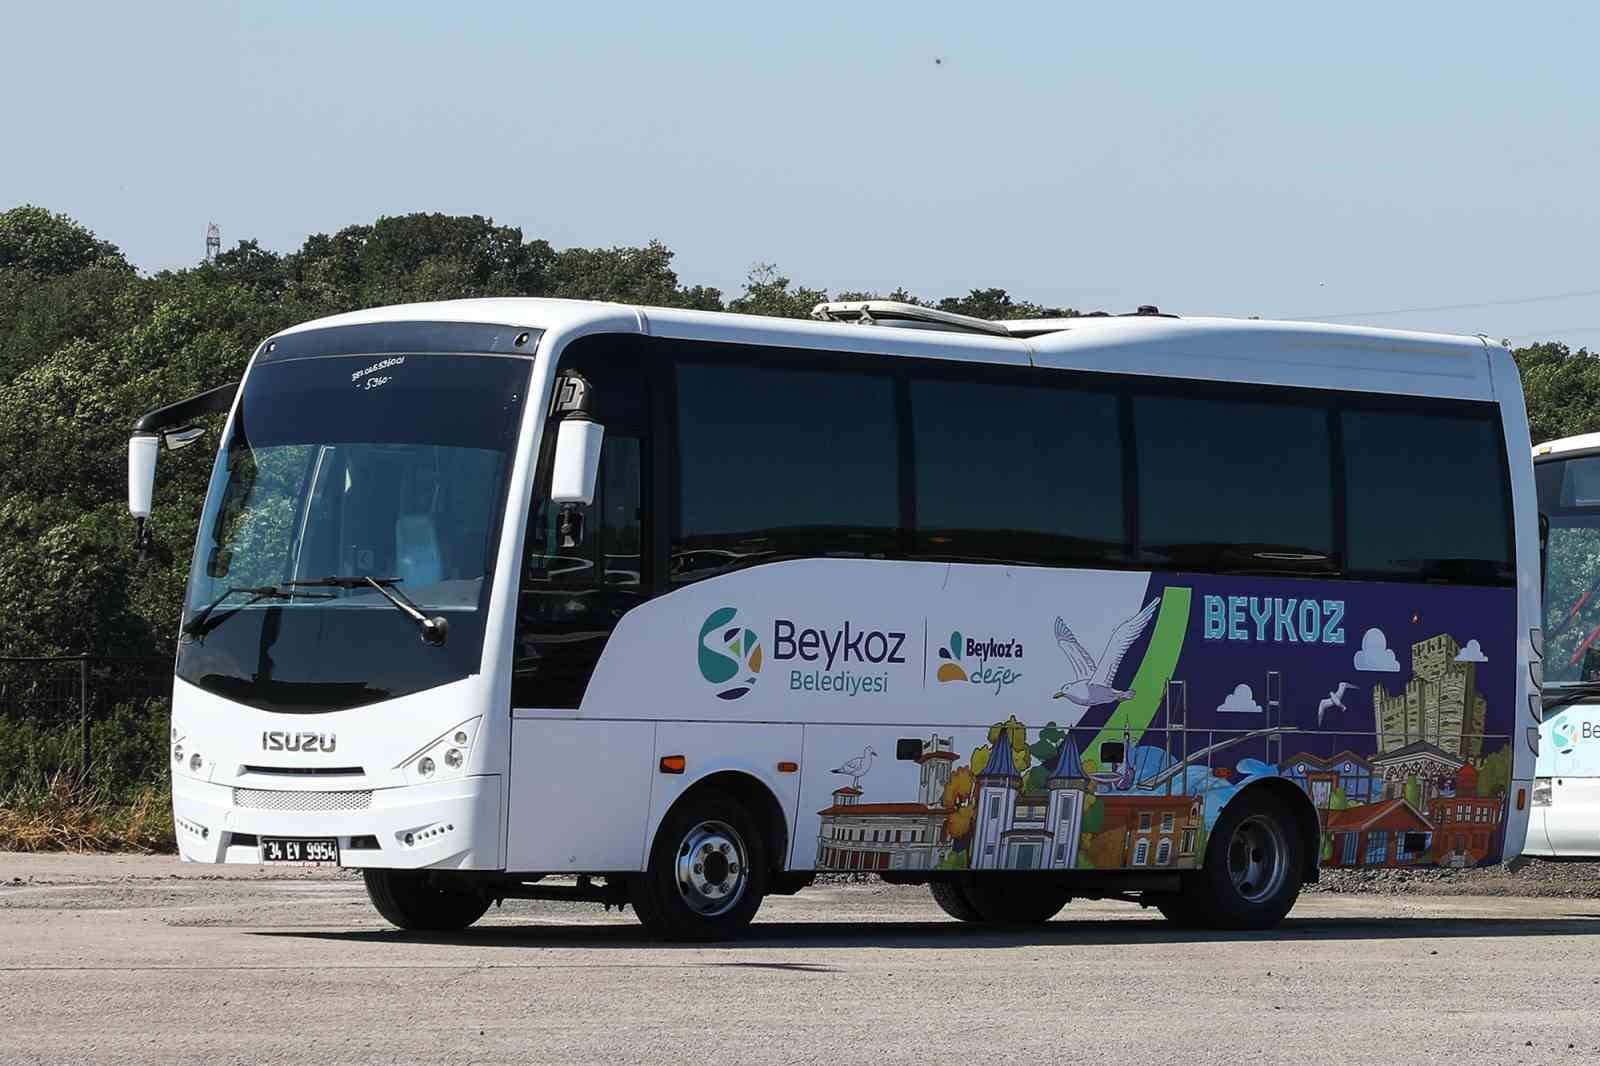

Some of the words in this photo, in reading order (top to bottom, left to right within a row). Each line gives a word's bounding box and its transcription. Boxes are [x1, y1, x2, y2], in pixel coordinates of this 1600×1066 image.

[1204, 595, 1345, 644] BEYKOZ
[773, 620, 906, 671] Beykoz
[966, 637, 1023, 662] Beykoz'a
[790, 670, 888, 696] Belediyesi
[970, 658, 1022, 696] değer
[262, 731, 336, 752] ISUZU
[268, 842, 282, 860] 34
[306, 842, 336, 860] 9954
